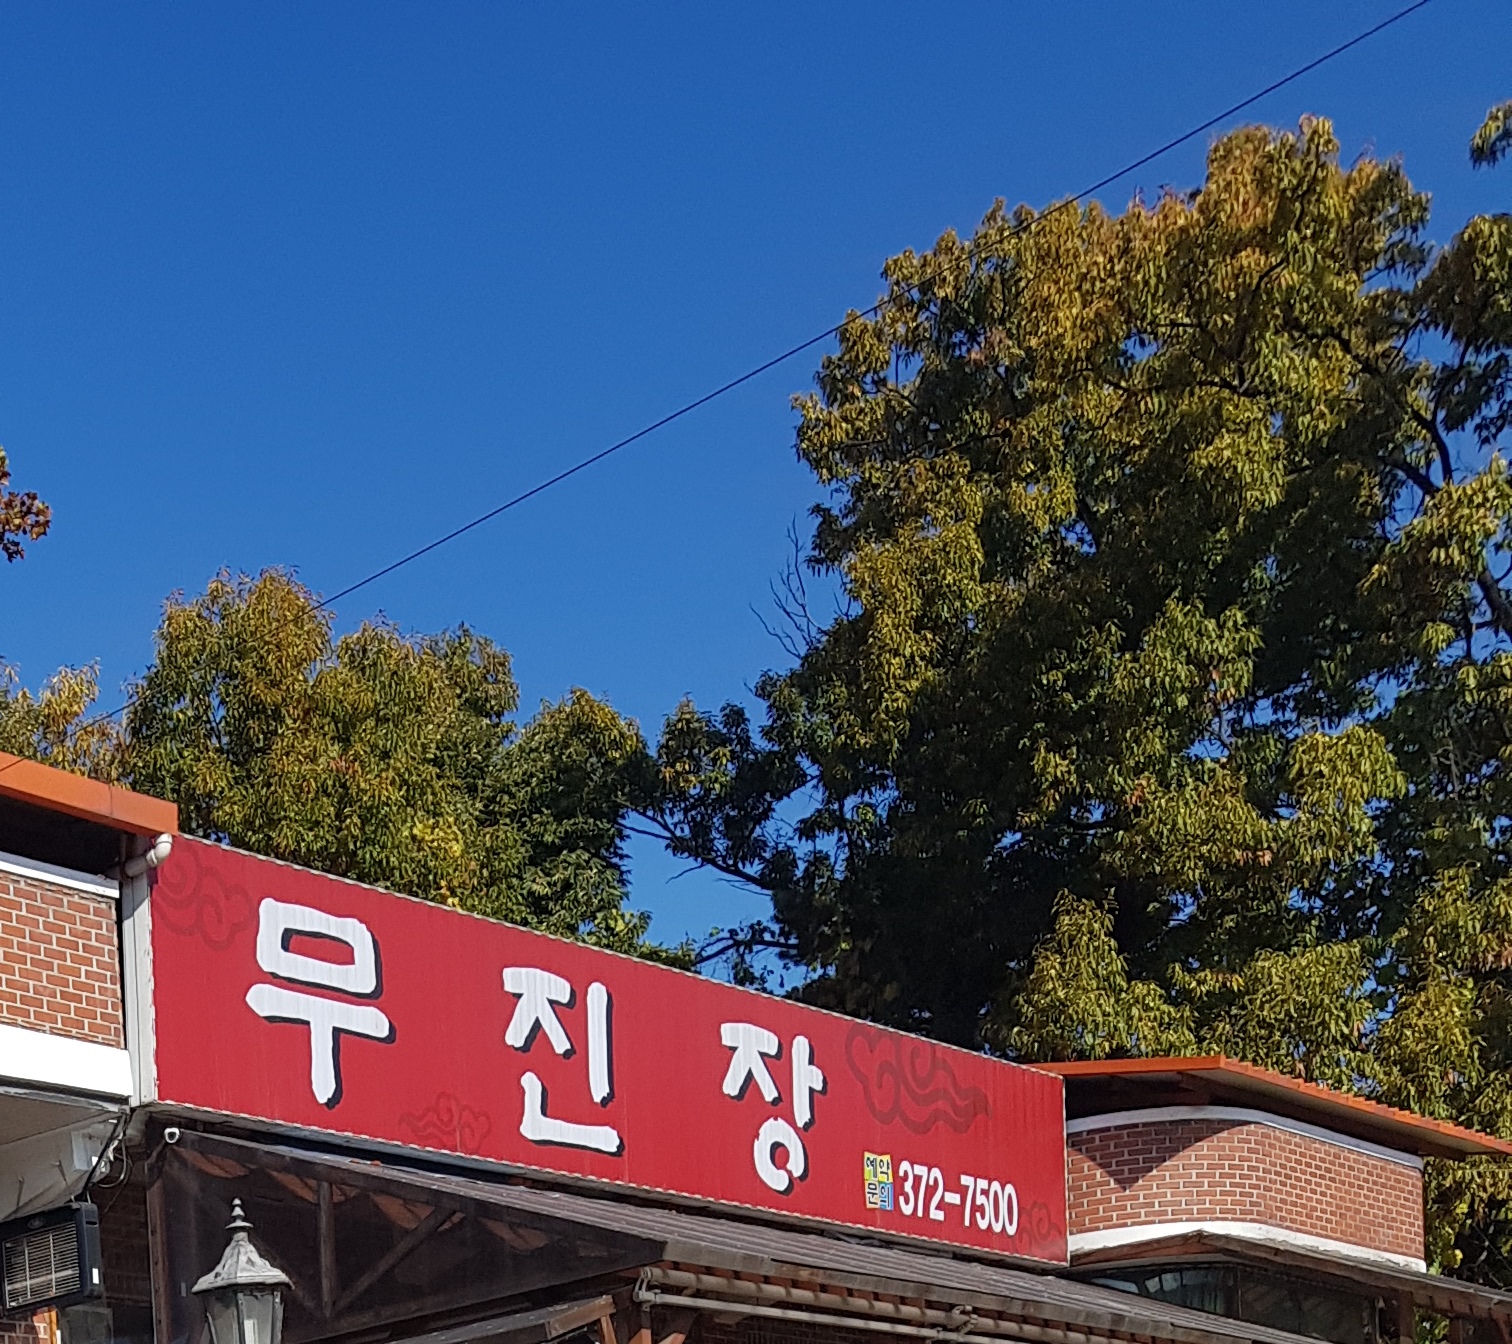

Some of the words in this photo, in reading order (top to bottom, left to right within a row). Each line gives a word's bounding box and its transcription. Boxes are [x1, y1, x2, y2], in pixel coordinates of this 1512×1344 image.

[245, 896, 827, 1193] 무진장
[866, 1156, 890, 1181] 예약
[867, 1182, 893, 1209] 문의
[898, 1160, 1019, 1236] 372-7500
